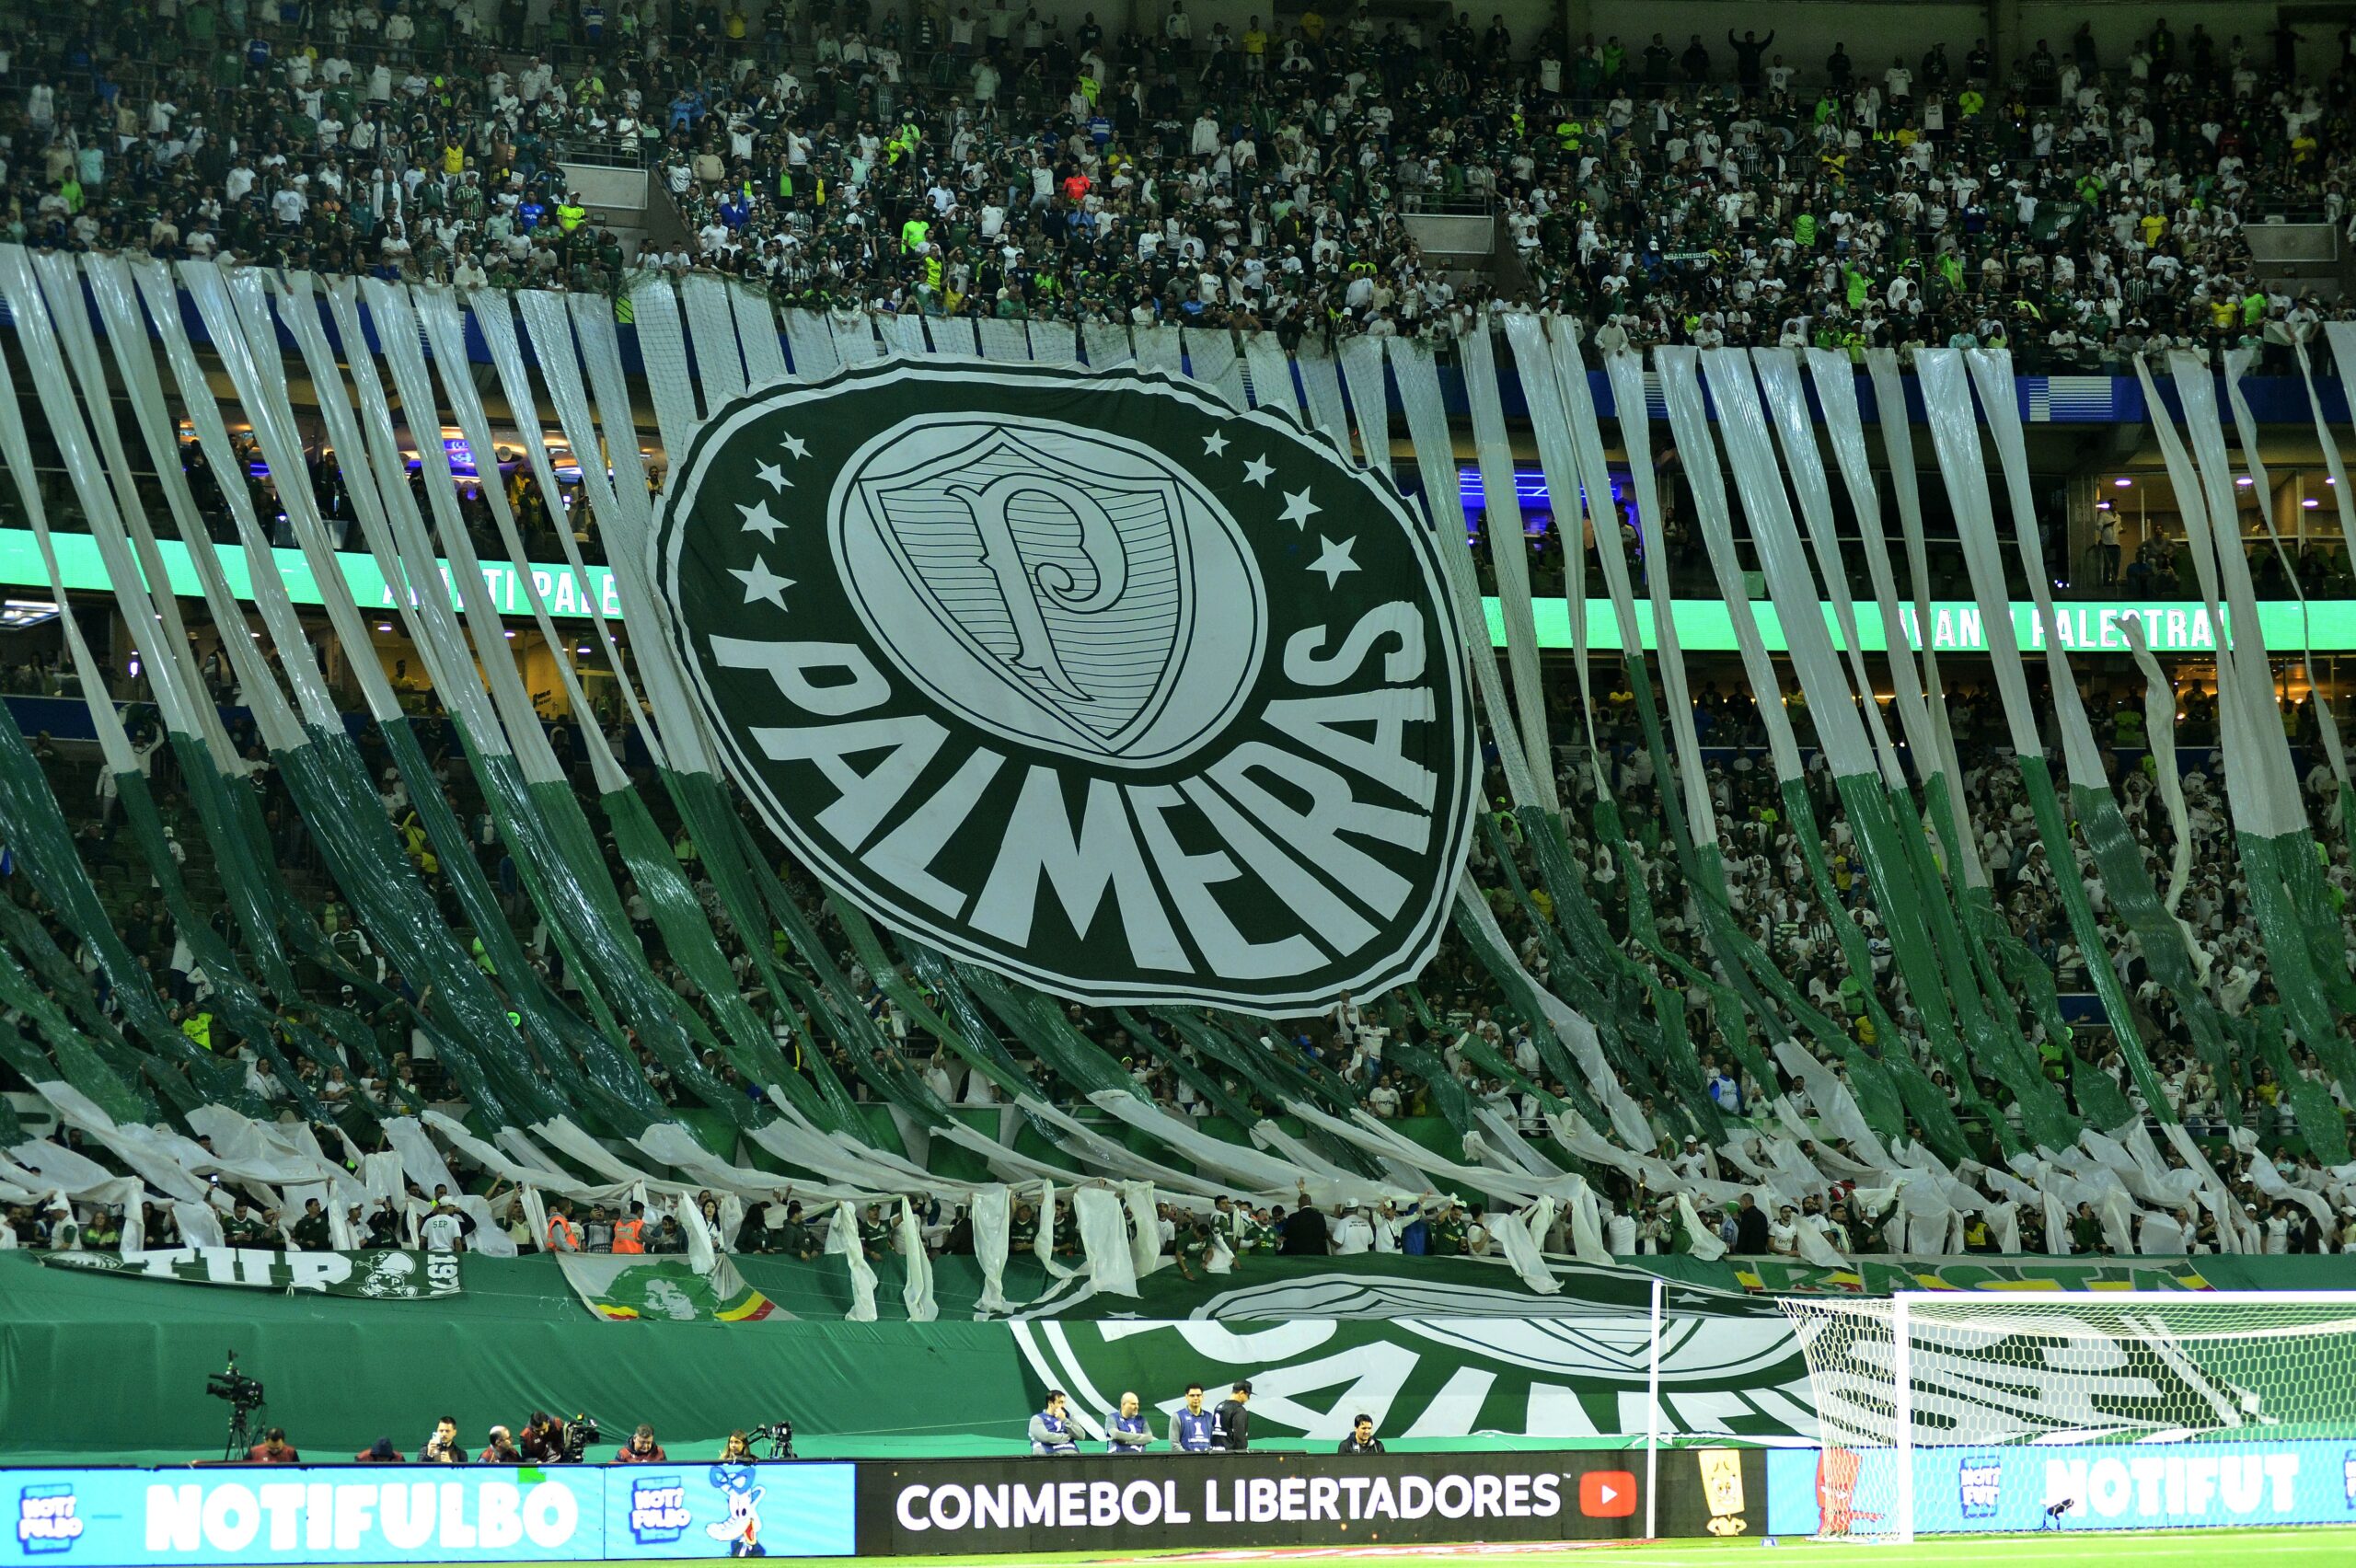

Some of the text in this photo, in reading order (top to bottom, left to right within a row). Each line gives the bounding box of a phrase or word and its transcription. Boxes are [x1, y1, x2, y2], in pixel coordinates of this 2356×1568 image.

[944, 473, 1128, 702] P
[709, 601, 1438, 979] PALMEIRAS
[433, 1220, 448, 1229] SEP
[144, 1480, 578, 1552] NOTIFULBO
[895, 1472, 1561, 1531] CONMEBOL LIBERTADORES
[2045, 1453, 2299, 1517] NOTIFUT
